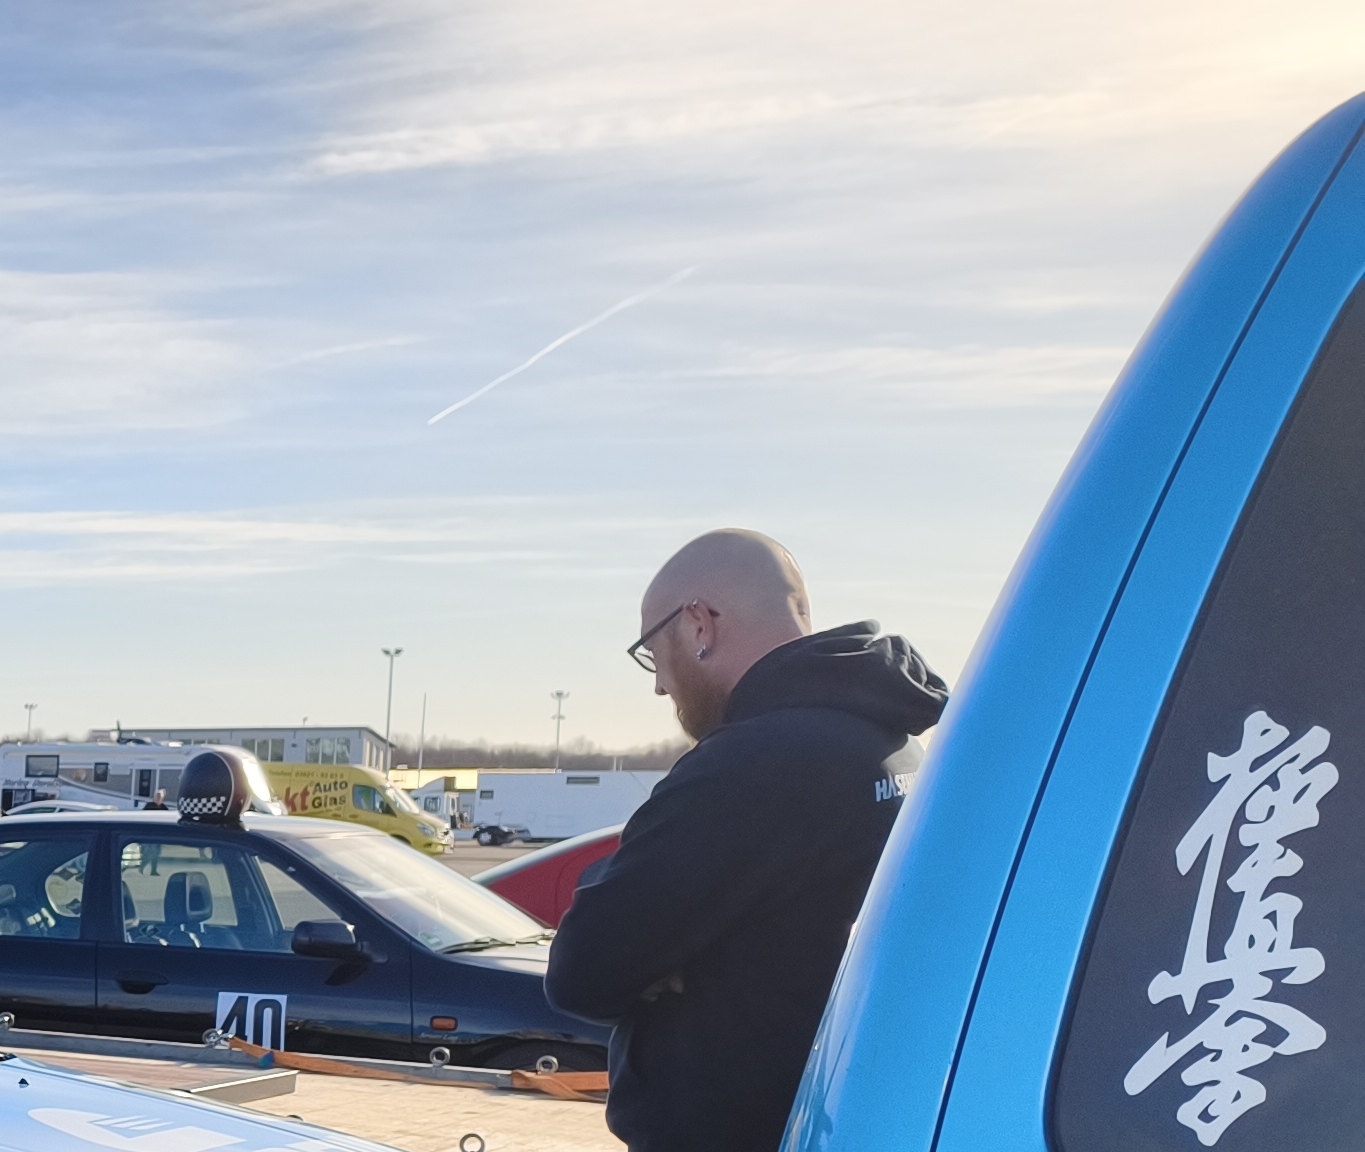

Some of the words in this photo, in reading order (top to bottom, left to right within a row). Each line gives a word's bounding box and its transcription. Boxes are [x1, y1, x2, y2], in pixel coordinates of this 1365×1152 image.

[312, 780, 349, 795] Auto
[311, 795, 347, 809] Glas
[220, 995, 283, 1051] 40
